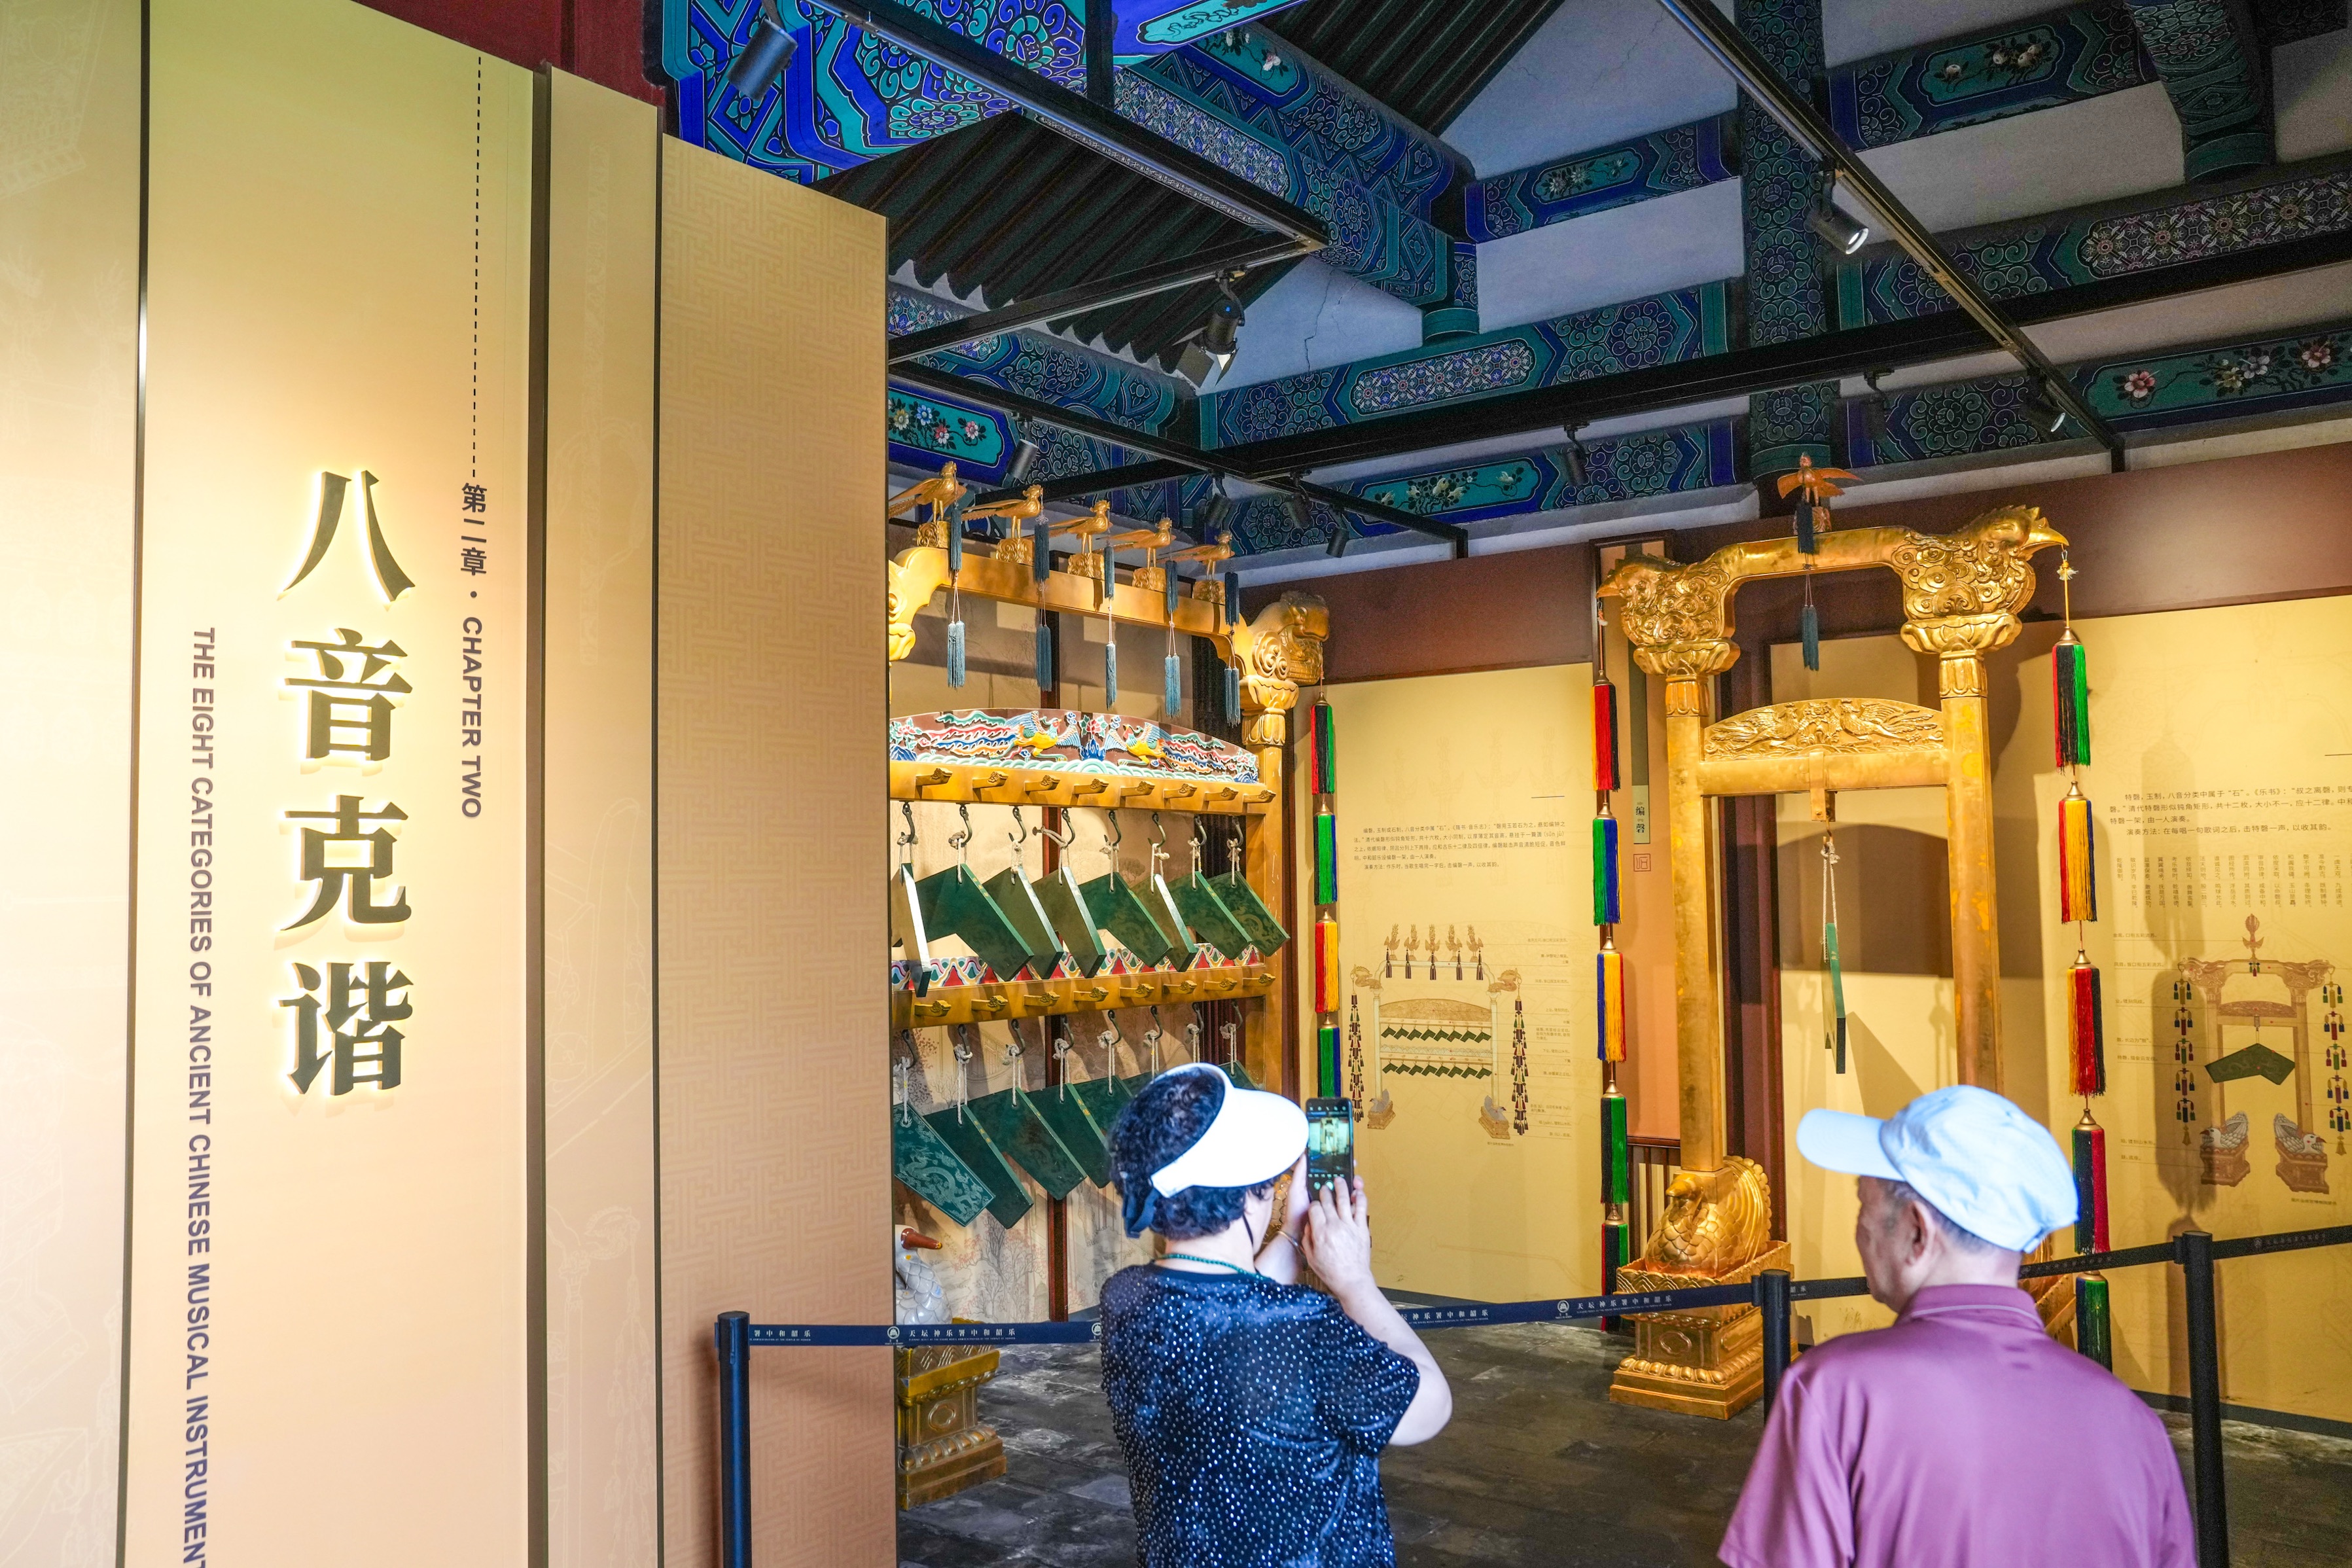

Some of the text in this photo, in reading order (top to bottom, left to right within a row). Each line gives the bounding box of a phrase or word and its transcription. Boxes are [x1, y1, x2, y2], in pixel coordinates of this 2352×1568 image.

[194, 628, 215, 679] THE
[462, 617, 482, 747] CHAPTER
[192, 688, 213, 769] EIGHT
[278, 469, 415, 1096] 八音克谐
[462, 755, 481, 817] TWO
[190, 777, 213, 952] CATEGORIES
[190, 961, 211, 997] OF
[189, 1005, 211, 1124] ANCIENT
[188, 1135, 210, 1256] CHINESE
[187, 1263, 209, 1390] MUSICAL
